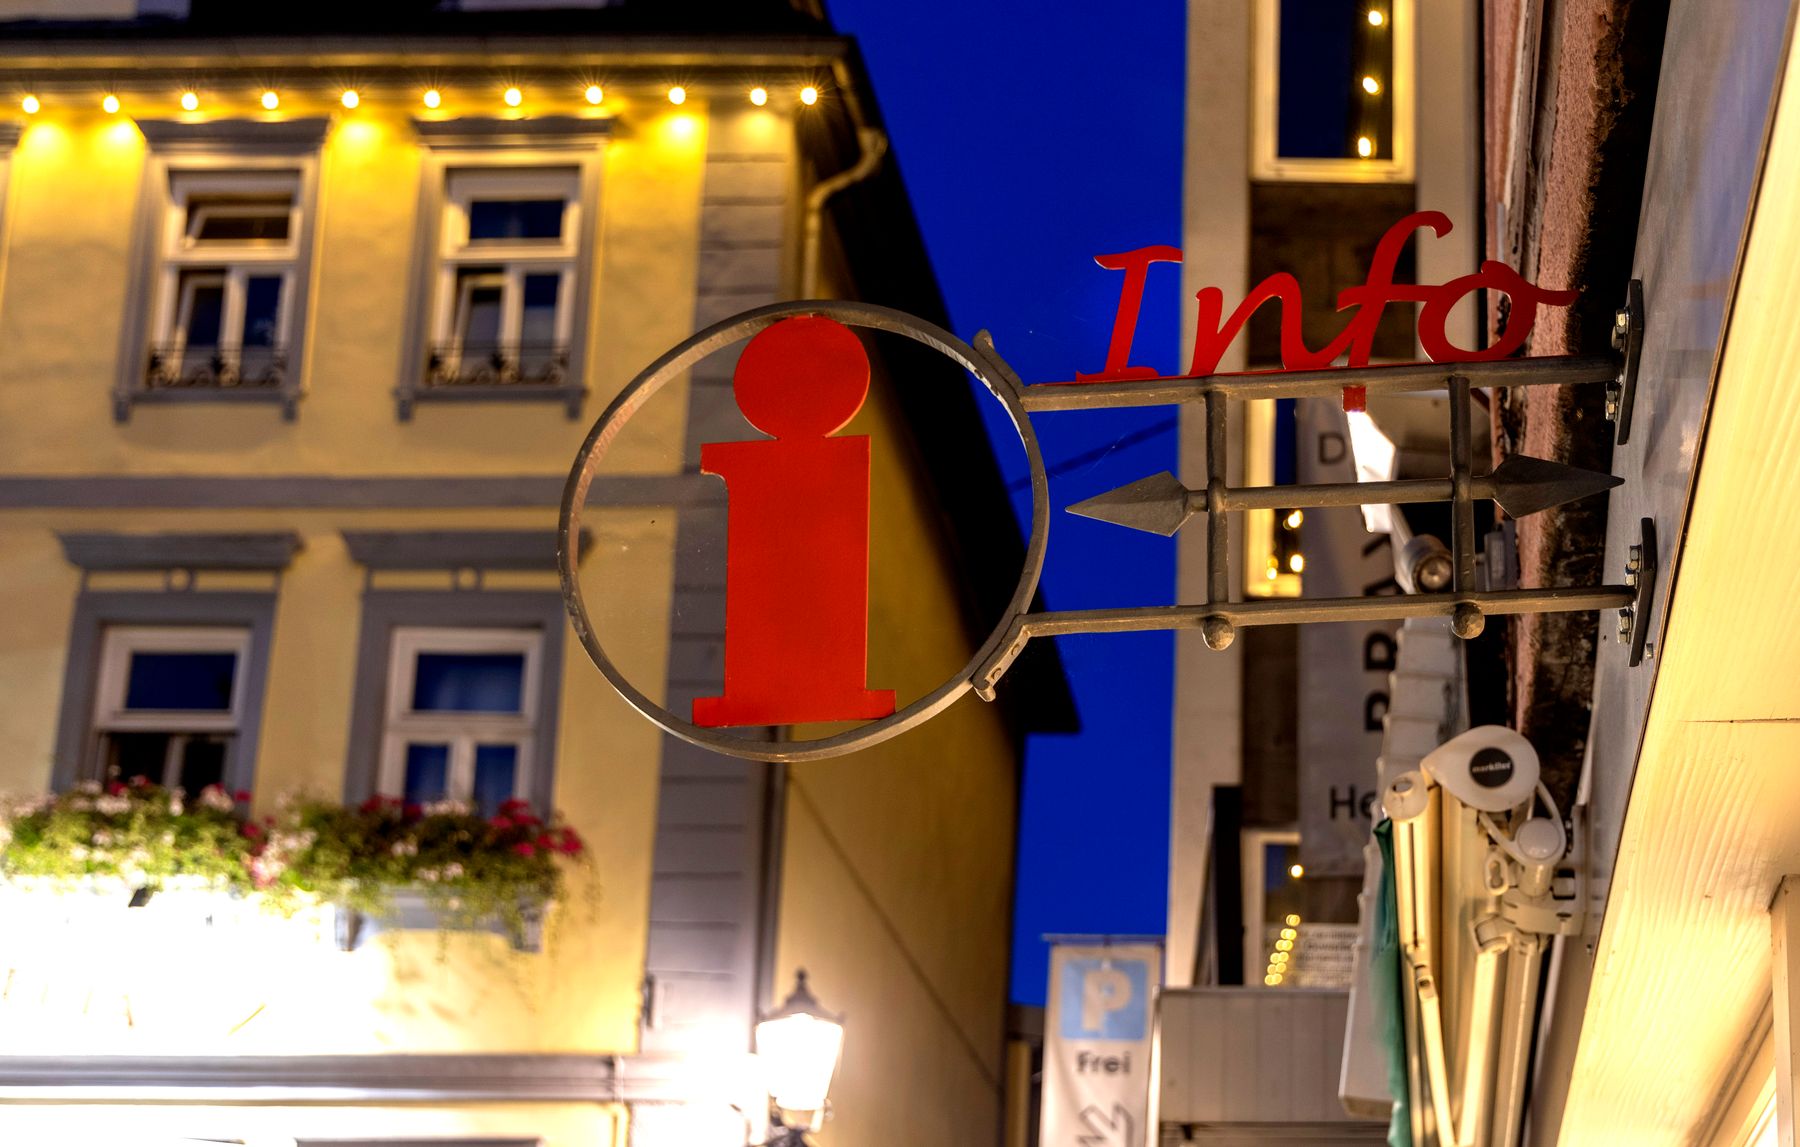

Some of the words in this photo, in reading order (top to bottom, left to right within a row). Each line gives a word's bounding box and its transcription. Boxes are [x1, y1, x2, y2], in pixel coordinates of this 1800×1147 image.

[1075, 211, 1578, 411] Info
[1082, 968, 1131, 1031] P
[1077, 1051, 1130, 1073] Frei
